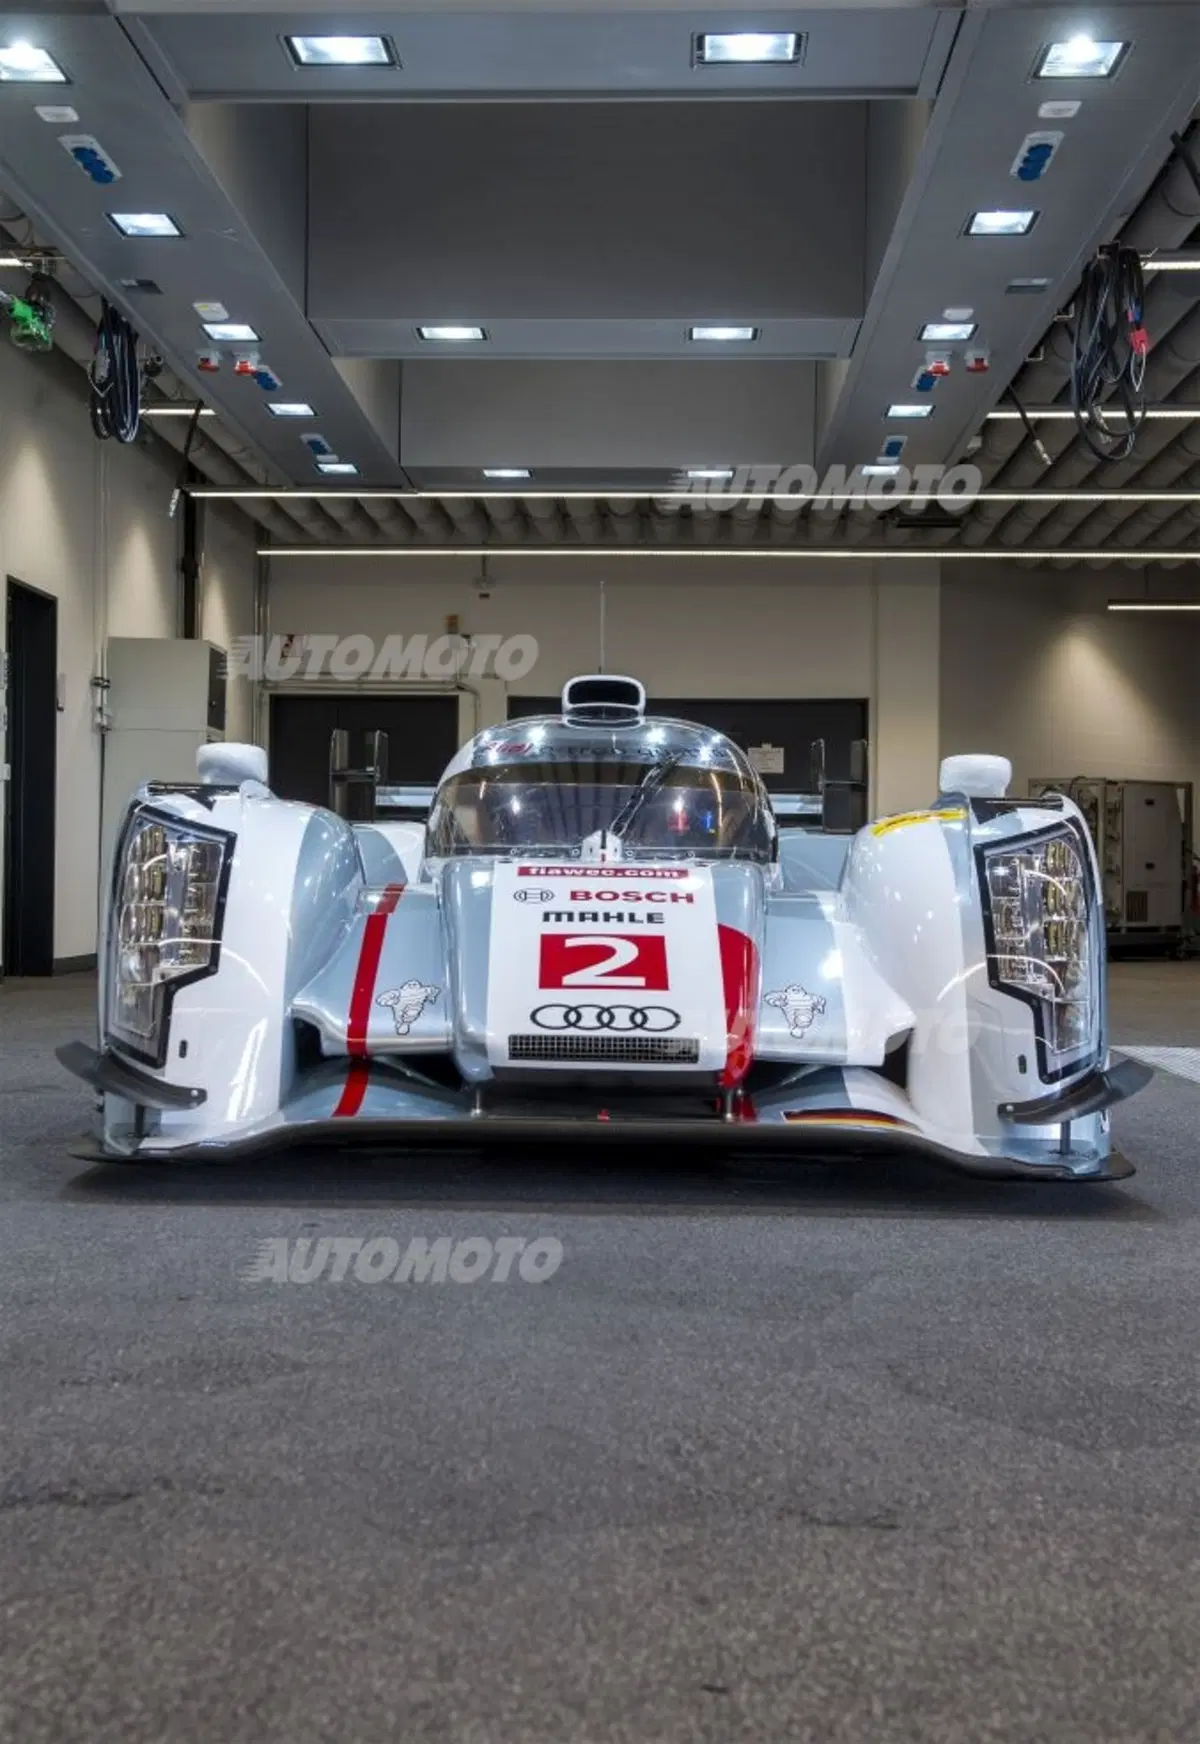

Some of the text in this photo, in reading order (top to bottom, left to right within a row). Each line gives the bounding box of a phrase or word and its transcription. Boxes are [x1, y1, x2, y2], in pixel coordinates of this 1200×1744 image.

[570, 890, 695, 904] BOSCH
[542, 911, 665, 924] MAHLE
[561, 935, 646, 987] 2
